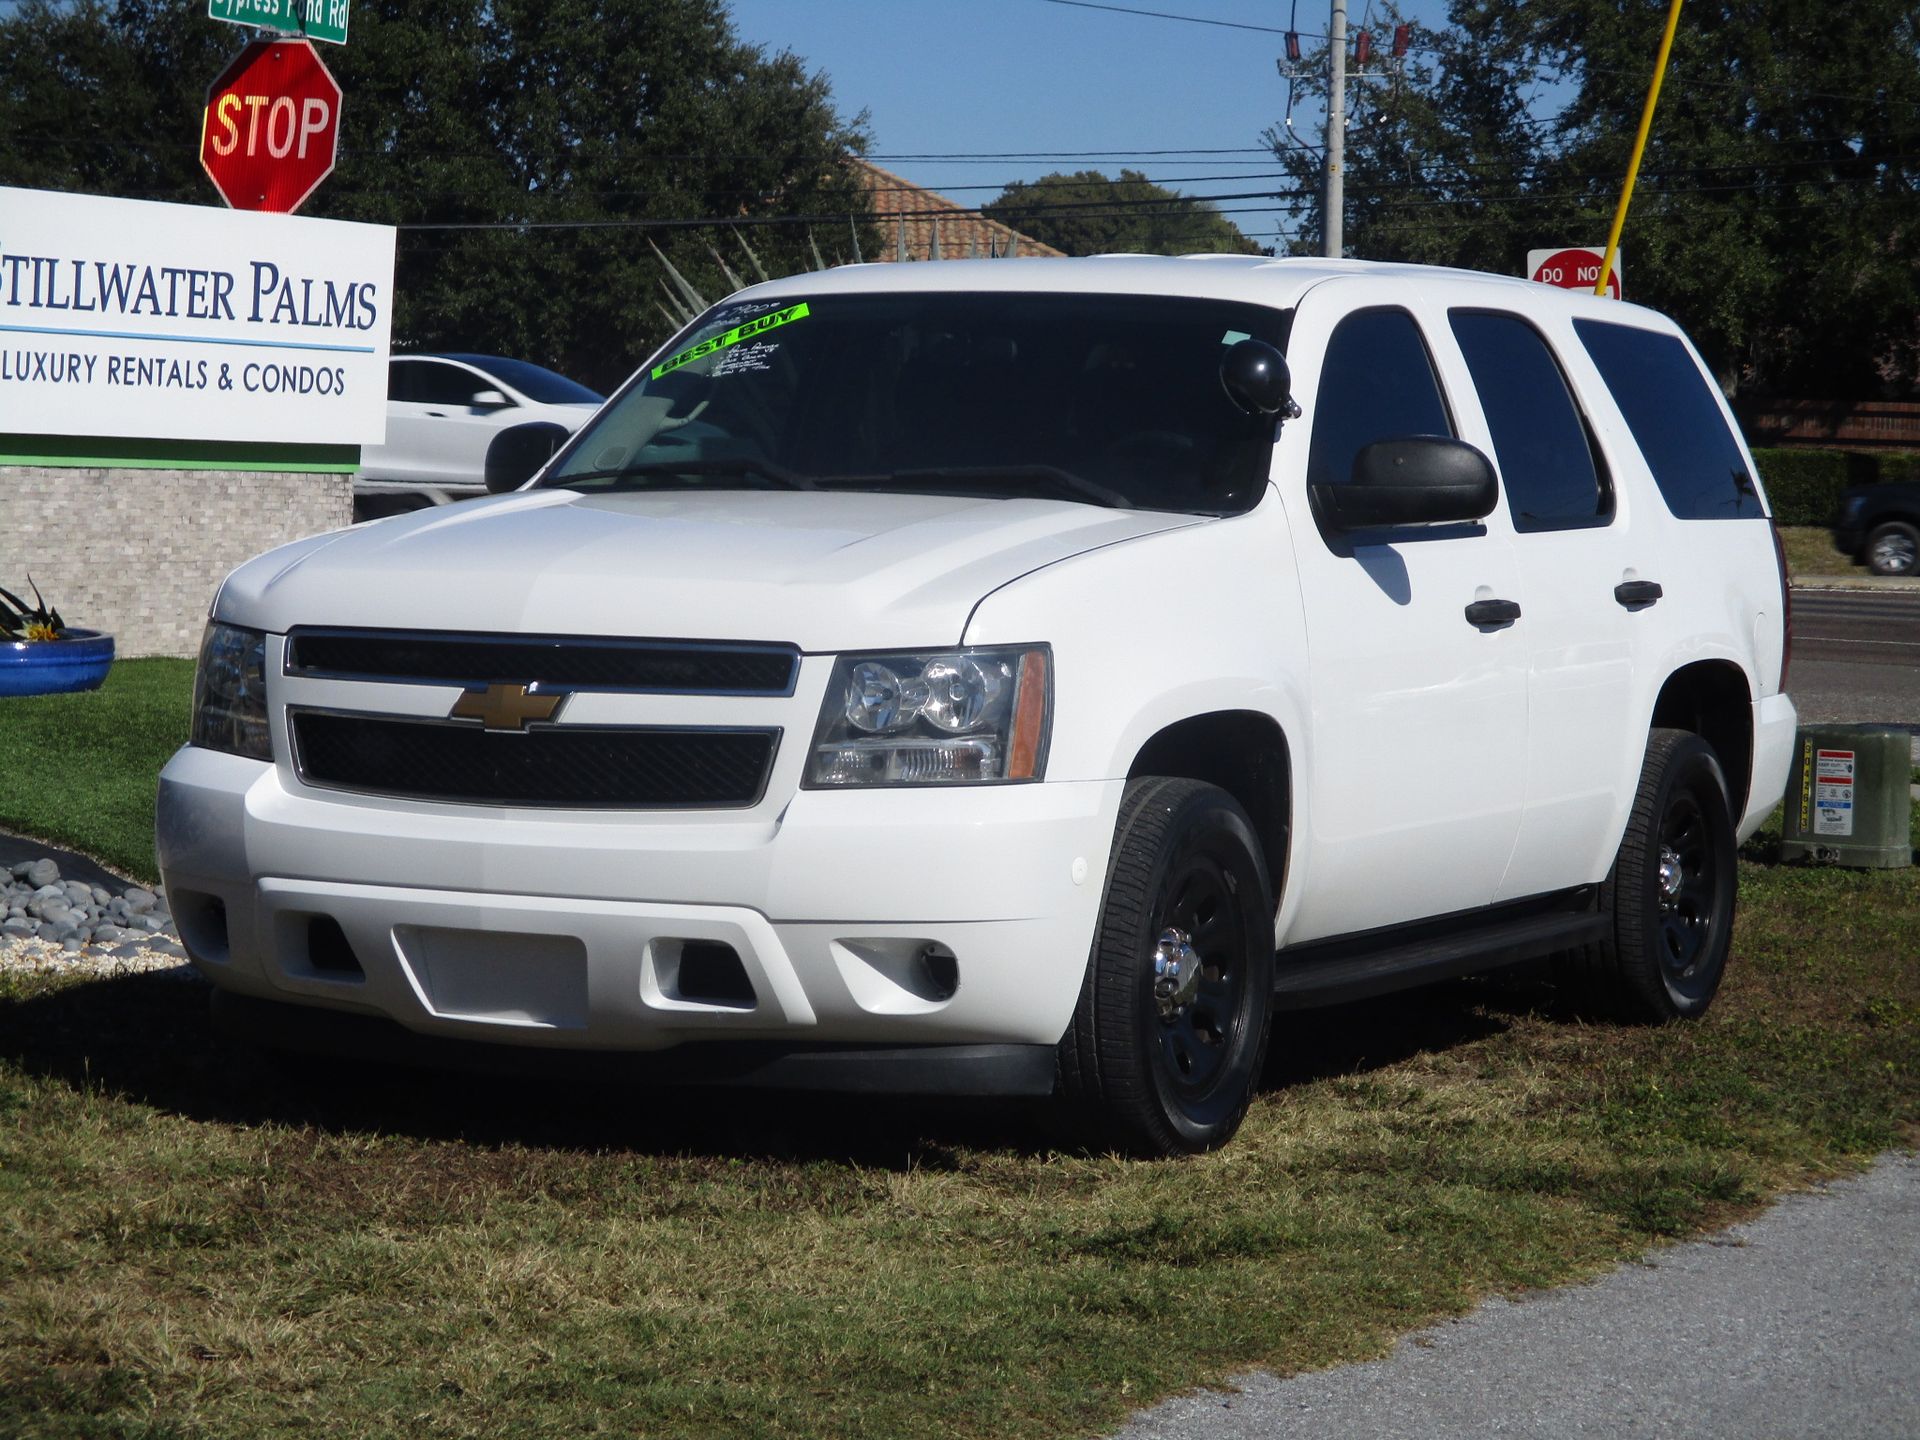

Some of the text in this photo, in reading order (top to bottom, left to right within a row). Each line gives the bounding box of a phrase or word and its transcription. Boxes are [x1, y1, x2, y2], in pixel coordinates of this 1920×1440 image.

[215, 0, 280, 16] ypess
[328, 0, 347, 29] Rd
[212, 93, 330, 160] STOP
[0, 241, 377, 331] TILLWATER PALMS
[1542, 267, 1563, 283] DO
[661, 332, 732, 373] BEST
[738, 306, 798, 338] BUY
[1, 350, 345, 396] LUXURY RENTALS & CONDOS
